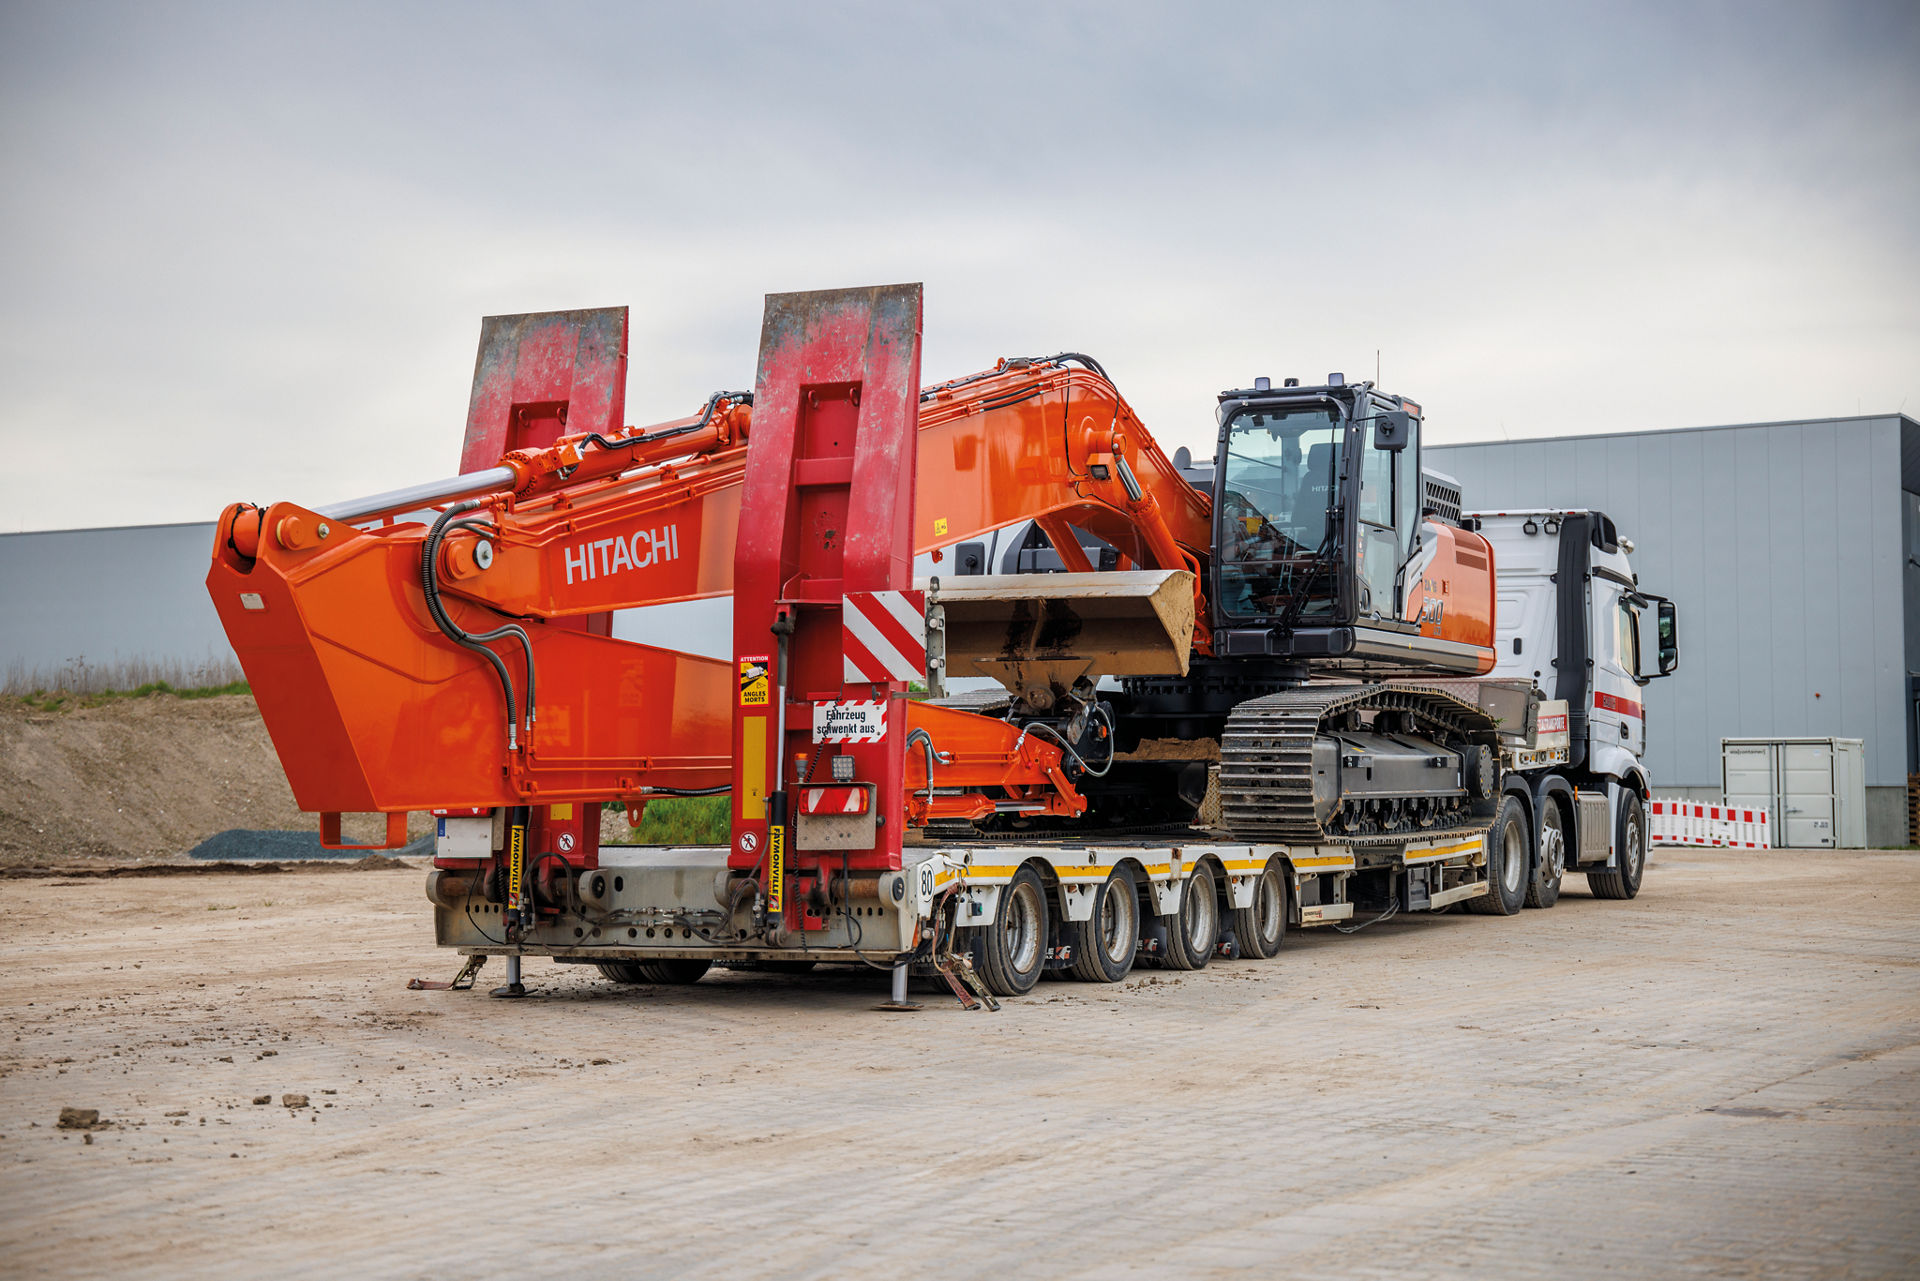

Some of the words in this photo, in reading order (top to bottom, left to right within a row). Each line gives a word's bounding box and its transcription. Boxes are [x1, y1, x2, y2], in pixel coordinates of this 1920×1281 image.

[564, 524, 679, 585] HITACHI
[1421, 596, 1443, 625] 300
[816, 723, 857, 734] schwenkt
[860, 725, 875, 733] aus
[826, 710, 866, 723] Fahrzeug
[511, 828, 520, 892] FAYMONVILLE
[772, 828, 781, 894] FAYMONVILLE
[921, 870, 933, 896] 80
